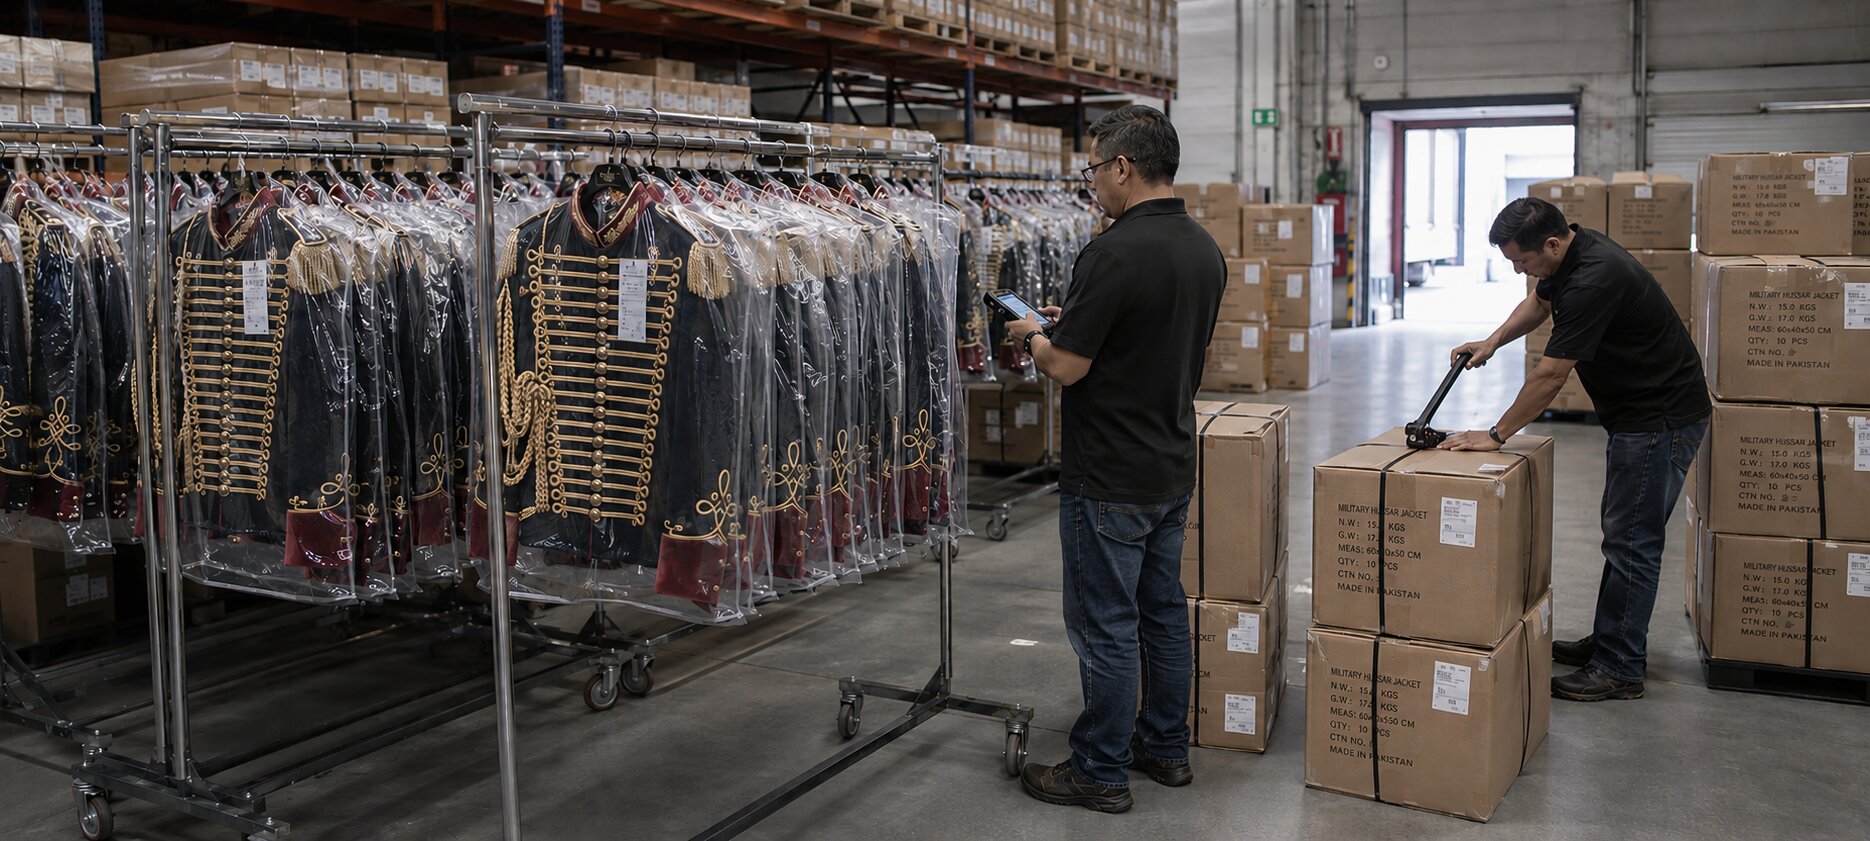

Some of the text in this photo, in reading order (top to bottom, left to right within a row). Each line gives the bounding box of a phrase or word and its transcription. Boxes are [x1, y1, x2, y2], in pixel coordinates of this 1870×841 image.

[1749, 291, 1840, 300] MILITARY HUSSAR JACKET
[1778, 303, 1795, 311] 15.0
[1778, 314, 1795, 322] 17.0
[1748, 325, 1775, 333] MEAS:
[1747, 337, 1769, 345] QTY:
[1777, 337, 1786, 345] 10
[1747, 348, 1765, 356] CTN
[1746, 359, 1831, 369] MADE IN PAKISTAN
[1740, 436, 1836, 447] MILITARY HUSSAR JAKET
[1792, 461, 1811, 469] KGS
[1739, 470, 1767, 478] MEAS:
[1784, 483, 1802, 491] PCS
[1738, 492, 1757, 500] CTN
[1759, 493, 1776, 501] NO.
[1338, 504, 1428, 519] MILITARY HUSAR JACKET
[1738, 502, 1764, 511] MADE
[1367, 521, 1380, 529] 15.
[1388, 522, 1406, 532] KGS
[1337, 531, 1405, 544] G.W: 17. KGS
[1338, 544, 1422, 559] MEAS: 60x0x50 CM
[1337, 557, 1359, 566] QTY:
[1367, 560, 1376, 568] 10
[1743, 562, 1777, 572] MILITARY
[1811, 567, 1837, 576] ACKET
[1337, 569, 1373, 581] CTN NO.
[1772, 576, 1790, 584] 15.0
[1794, 578, 1807, 586] KG
[1337, 582, 1362, 593] MADE
[1365, 585, 1374, 594] IN
[1794, 589, 1807, 597] KG
[1742, 595, 1829, 609] MEAS: 60x40x5 CM
[1787, 611, 1804, 619] PCS
[1741, 617, 1760, 625] CTN
[1740, 628, 1767, 637] MADE
[1781, 632, 1827, 642] PAKISAN
[1330, 667, 1421, 689] MILITARY HUSAR JACKET
[1360, 686, 1372, 695] 15.
[1381, 690, 1399, 699] KGS
[1380, 703, 1398, 713] KGS
[1330, 706, 1356, 718] MEAS:
[1401, 719, 1415, 728] CM
[1329, 720, 1351, 731] QTY:
[1358, 725, 1368, 733] 10
[1329, 733, 1366, 747] CTN NO.
[1329, 745, 1355, 756] MADE
[1357, 750, 1366, 759] IN
